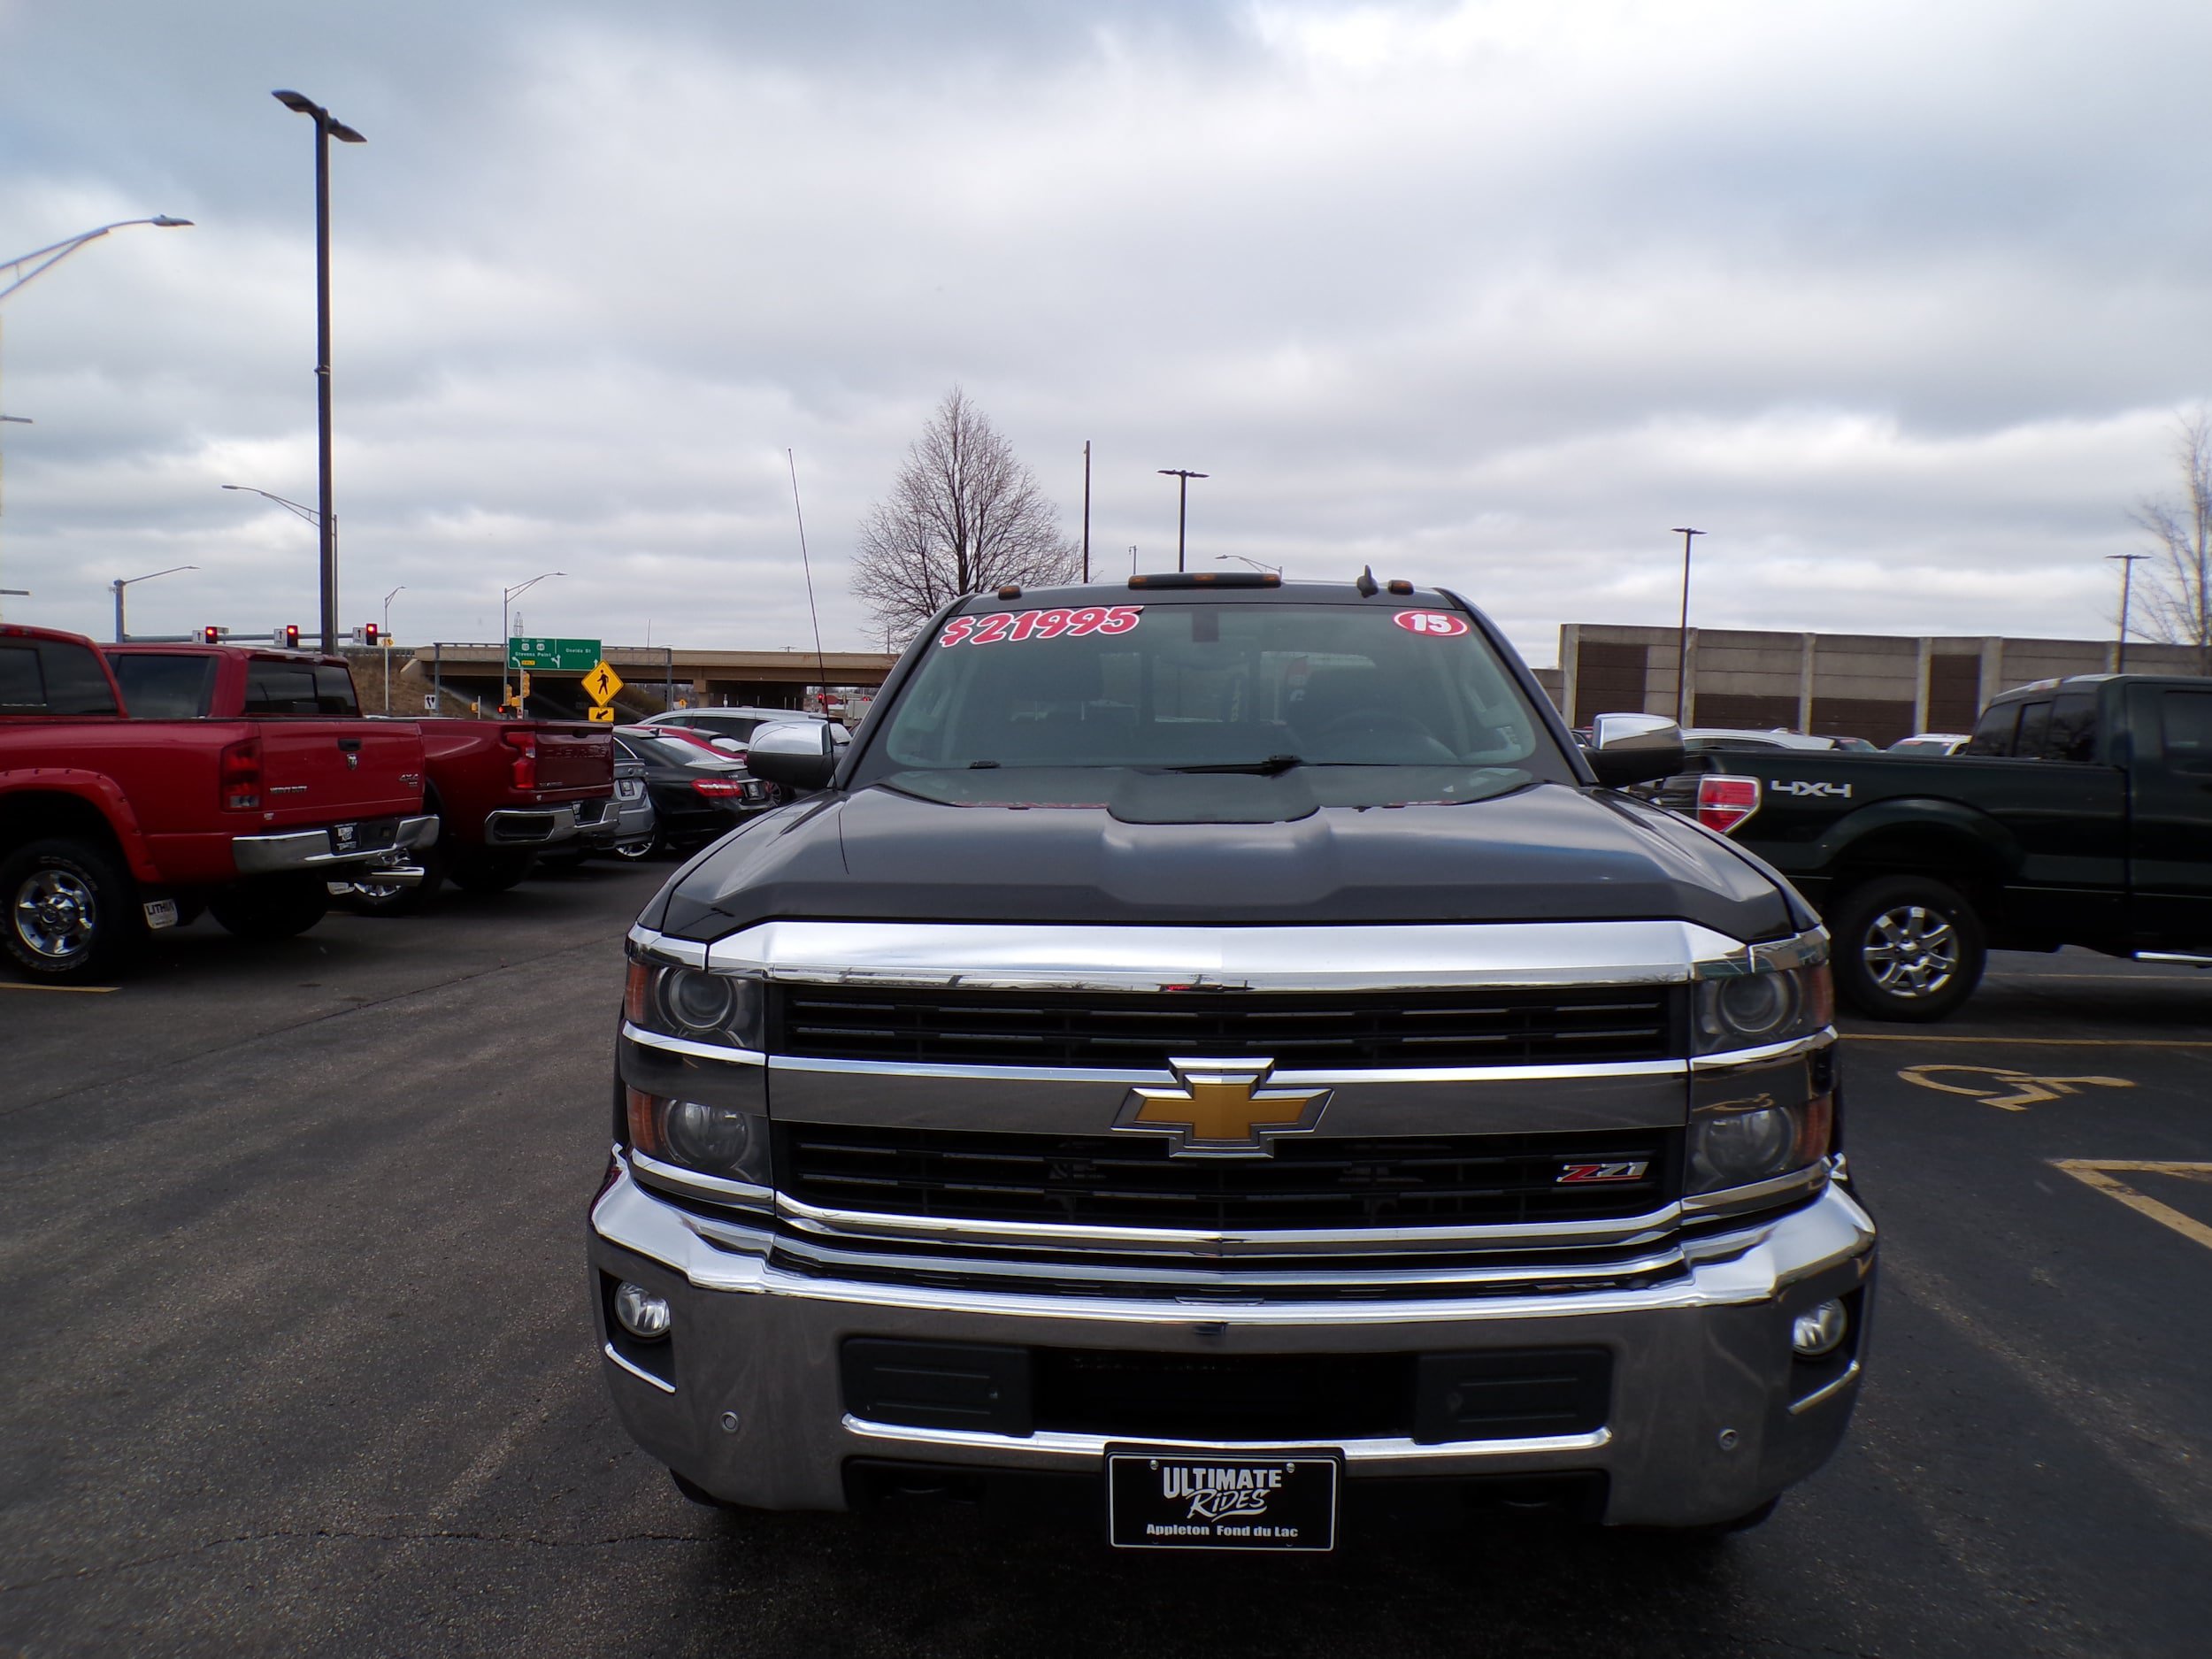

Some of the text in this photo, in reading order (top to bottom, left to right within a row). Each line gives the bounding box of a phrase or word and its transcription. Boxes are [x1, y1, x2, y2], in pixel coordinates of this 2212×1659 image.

[939, 605, 1144, 648] $21995
[1410, 613, 1452, 634] 15
[1163, 1466, 1282, 1499] ULTIMATE
[1146, 1524, 1299, 1538] Appleton Fond du Lac
